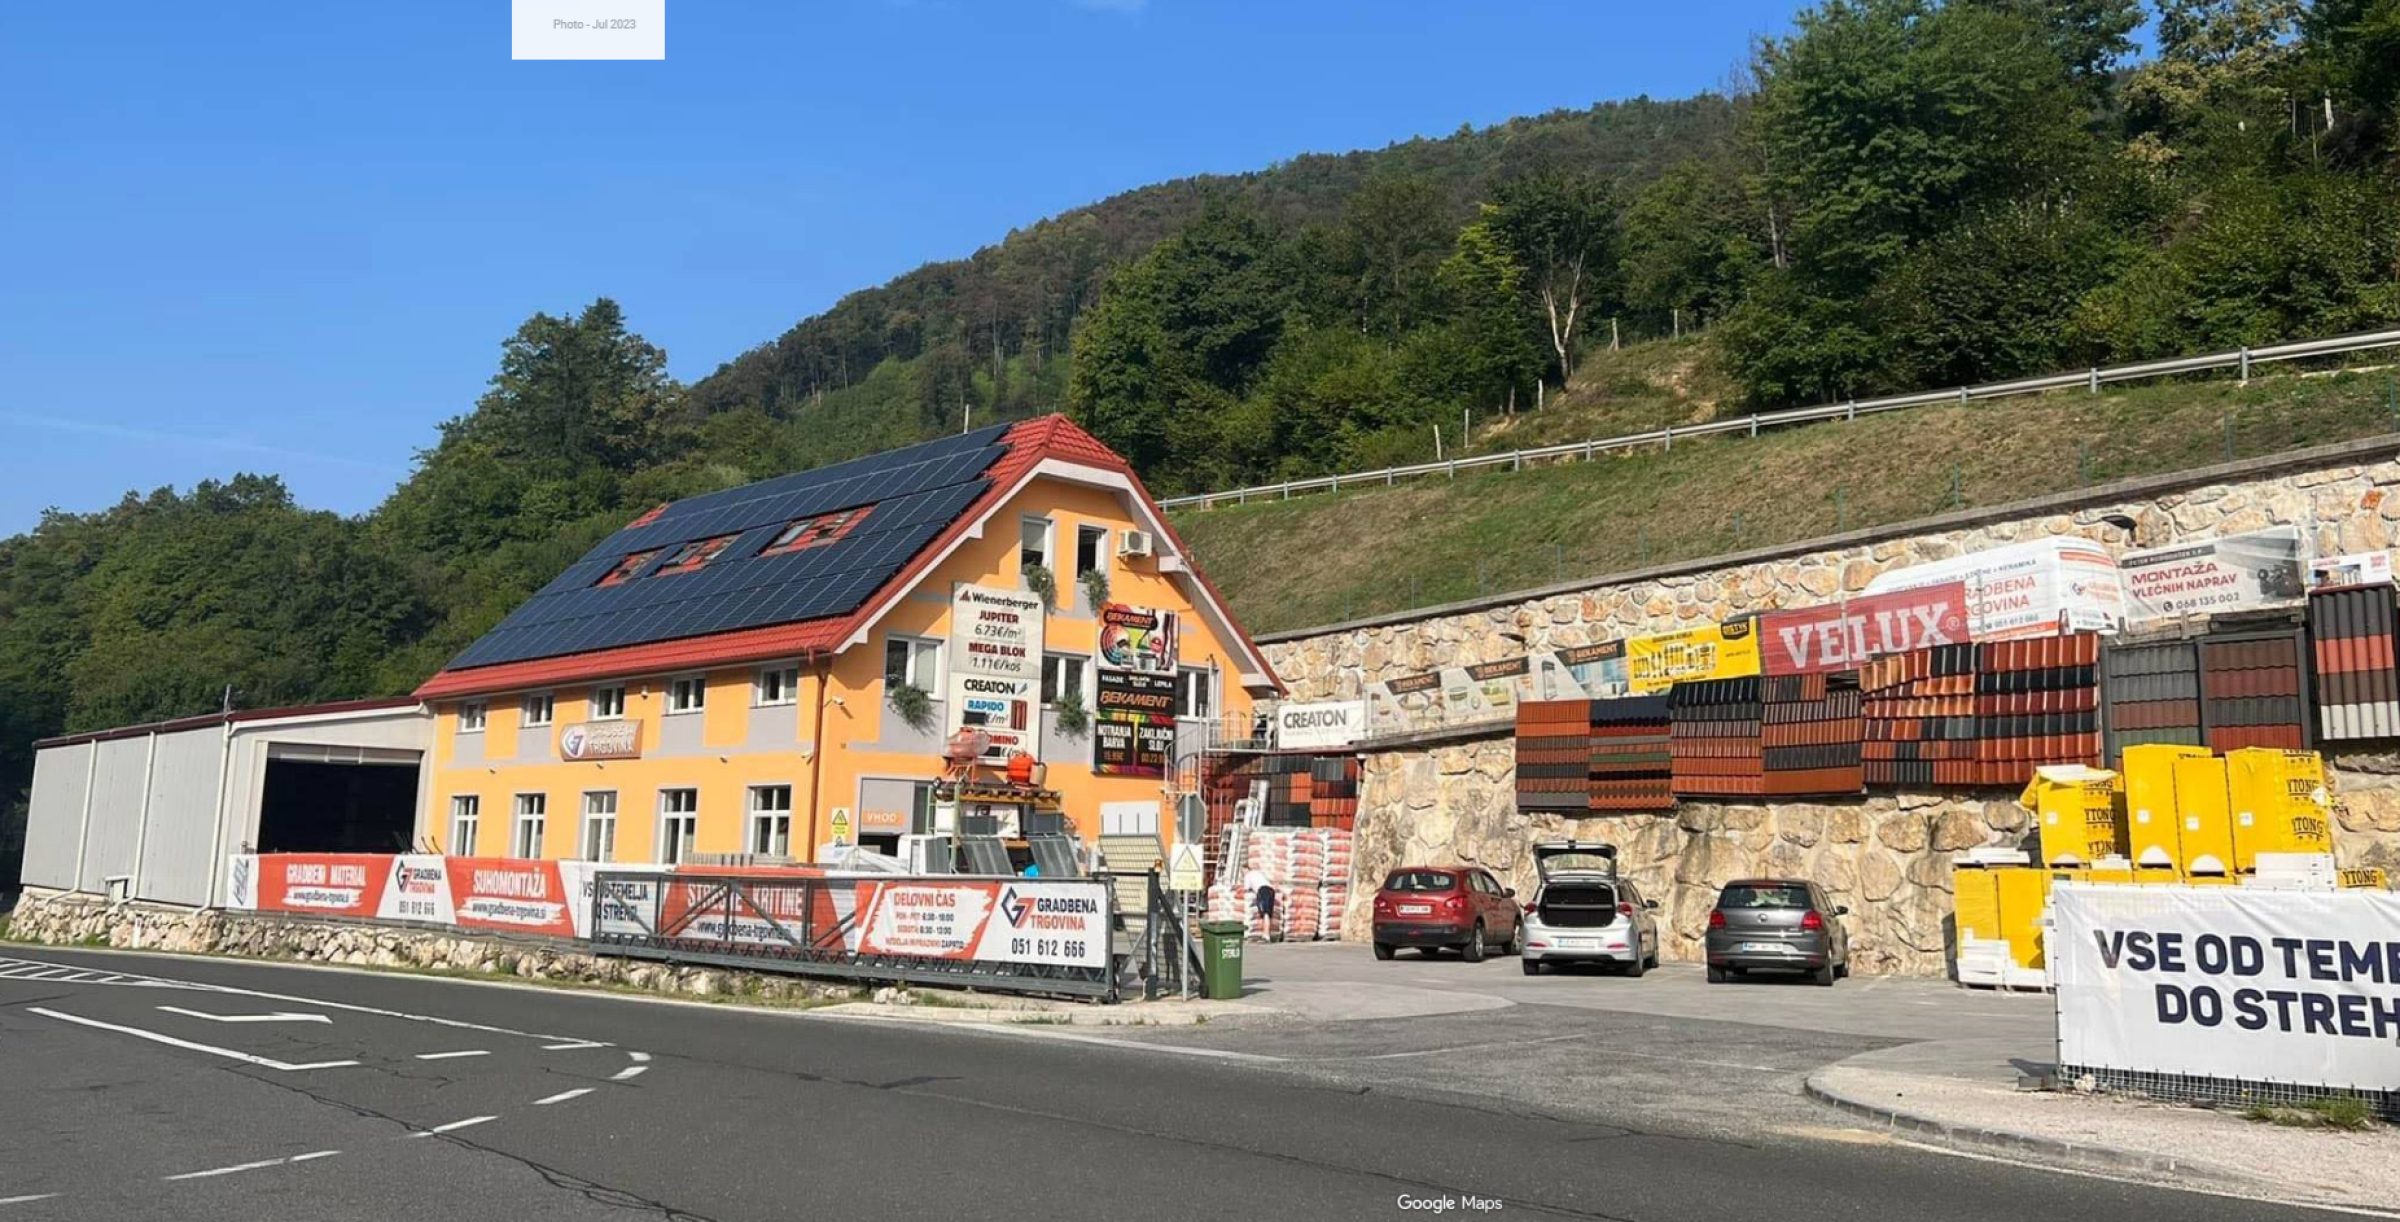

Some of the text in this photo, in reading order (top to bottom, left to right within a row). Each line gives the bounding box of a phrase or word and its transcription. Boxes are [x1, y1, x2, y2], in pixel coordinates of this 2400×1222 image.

[2131, 562, 2218, 585] MONTAŽA
[1965, 575, 2036, 600] RADBENA
[2132, 581, 2184, 599] VLEČNIH
[2187, 573, 2237, 592] NAPRAV
[972, 592, 1038, 610] Wienerberger
[2176, 601, 2197, 610] 068
[979, 610, 1019, 624] JUPITER
[968, 643, 1026, 657] MEGA BLOK
[964, 679, 1015, 694] CREATON
[968, 700, 1004, 711] RAPIDO
[1101, 691, 1167, 708] BEKAMENT
[1284, 709, 1346, 729] CREATON
[866, 813, 897, 823] VHOD
[2085, 808, 2116, 821] YTONG
[473, 867, 546, 898] SUHOMONTAŽA
[2342, 870, 2378, 885] YTONG
[894, 890, 955, 907] DELOVNI ČAS
[1037, 898, 1097, 913] GRADBENA
[1031, 915, 1086, 931] TRGOVINA
[1012, 938, 1086, 958] 051 612 666
[2093, 930, 2186, 972] VSE
[2195, 934, 2264, 976] OD
[2155, 984, 2223, 1027] DO
